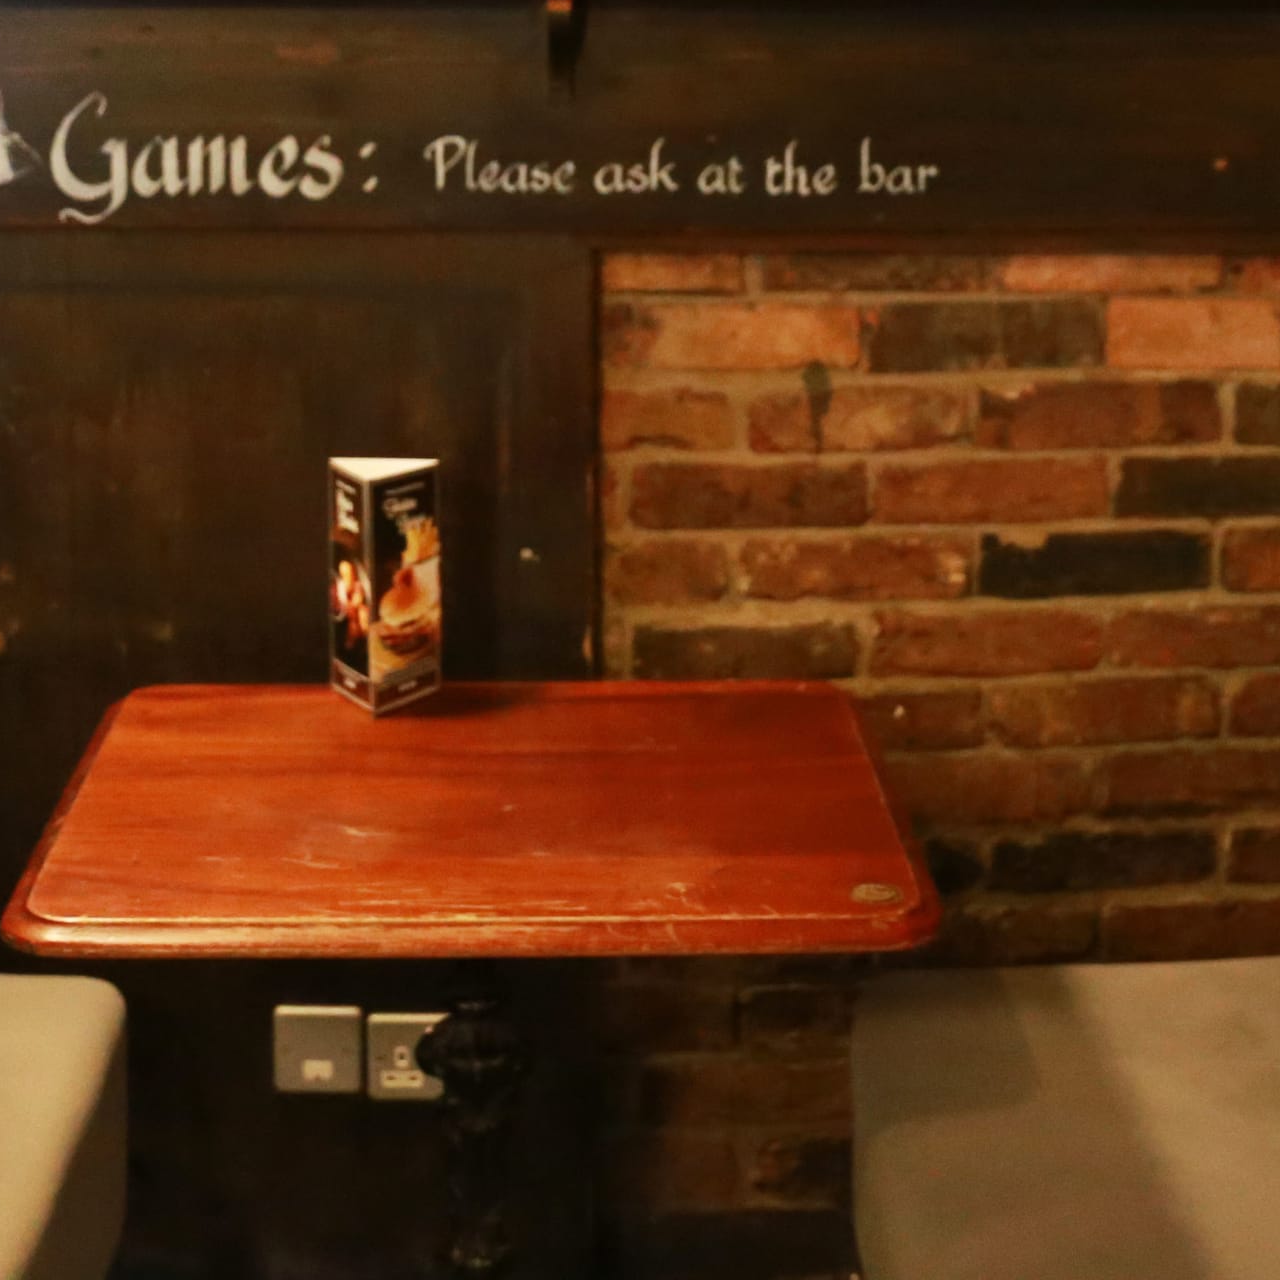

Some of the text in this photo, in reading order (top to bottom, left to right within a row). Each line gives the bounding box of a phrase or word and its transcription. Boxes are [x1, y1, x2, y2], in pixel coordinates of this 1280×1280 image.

[50, 91, 378, 225] Games:
[423, 134, 576, 194] Please
[593, 137, 679, 194] ask
[697, 156, 744, 194] at
[765, 140, 837, 195] the
[857, 136, 939, 195] bar
